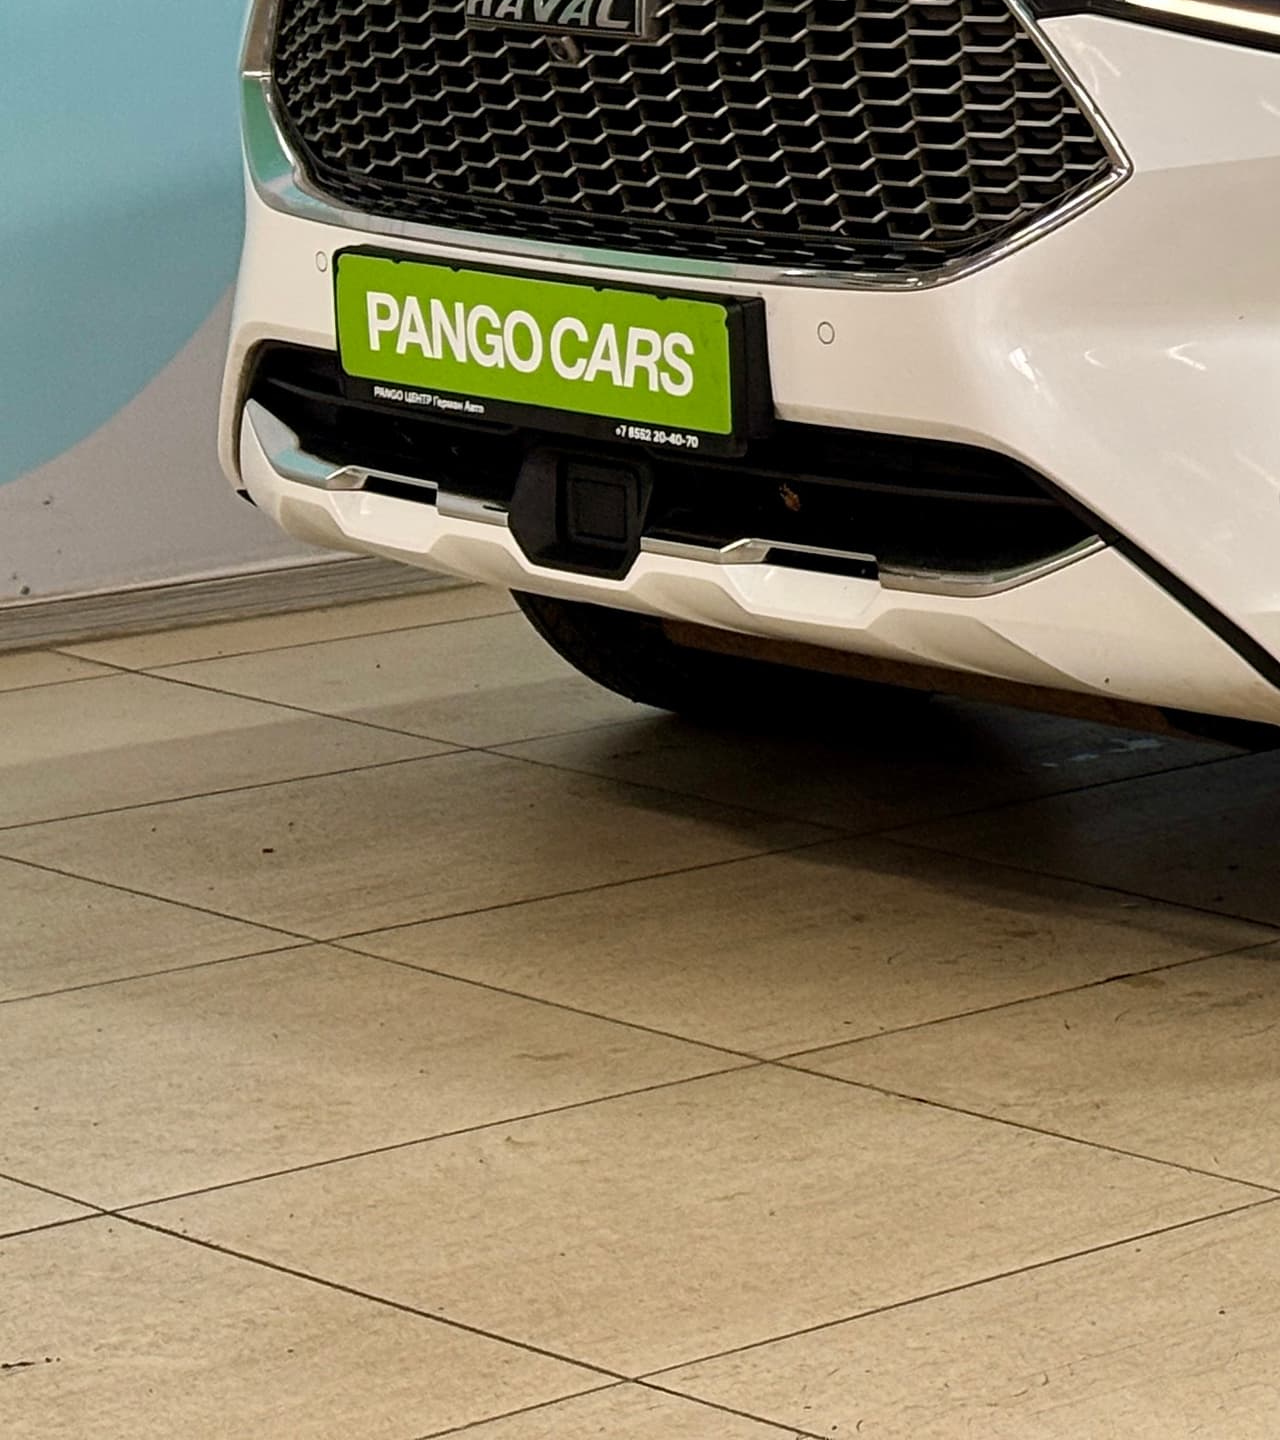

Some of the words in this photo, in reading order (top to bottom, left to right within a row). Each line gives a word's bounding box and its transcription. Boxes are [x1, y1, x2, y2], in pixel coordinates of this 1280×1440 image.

[365, 290, 544, 374] PANGO
[550, 317, 694, 397] CARS
[373, 385, 403, 402] PANGO
[653, 430, 699, 449] 20-40-70
